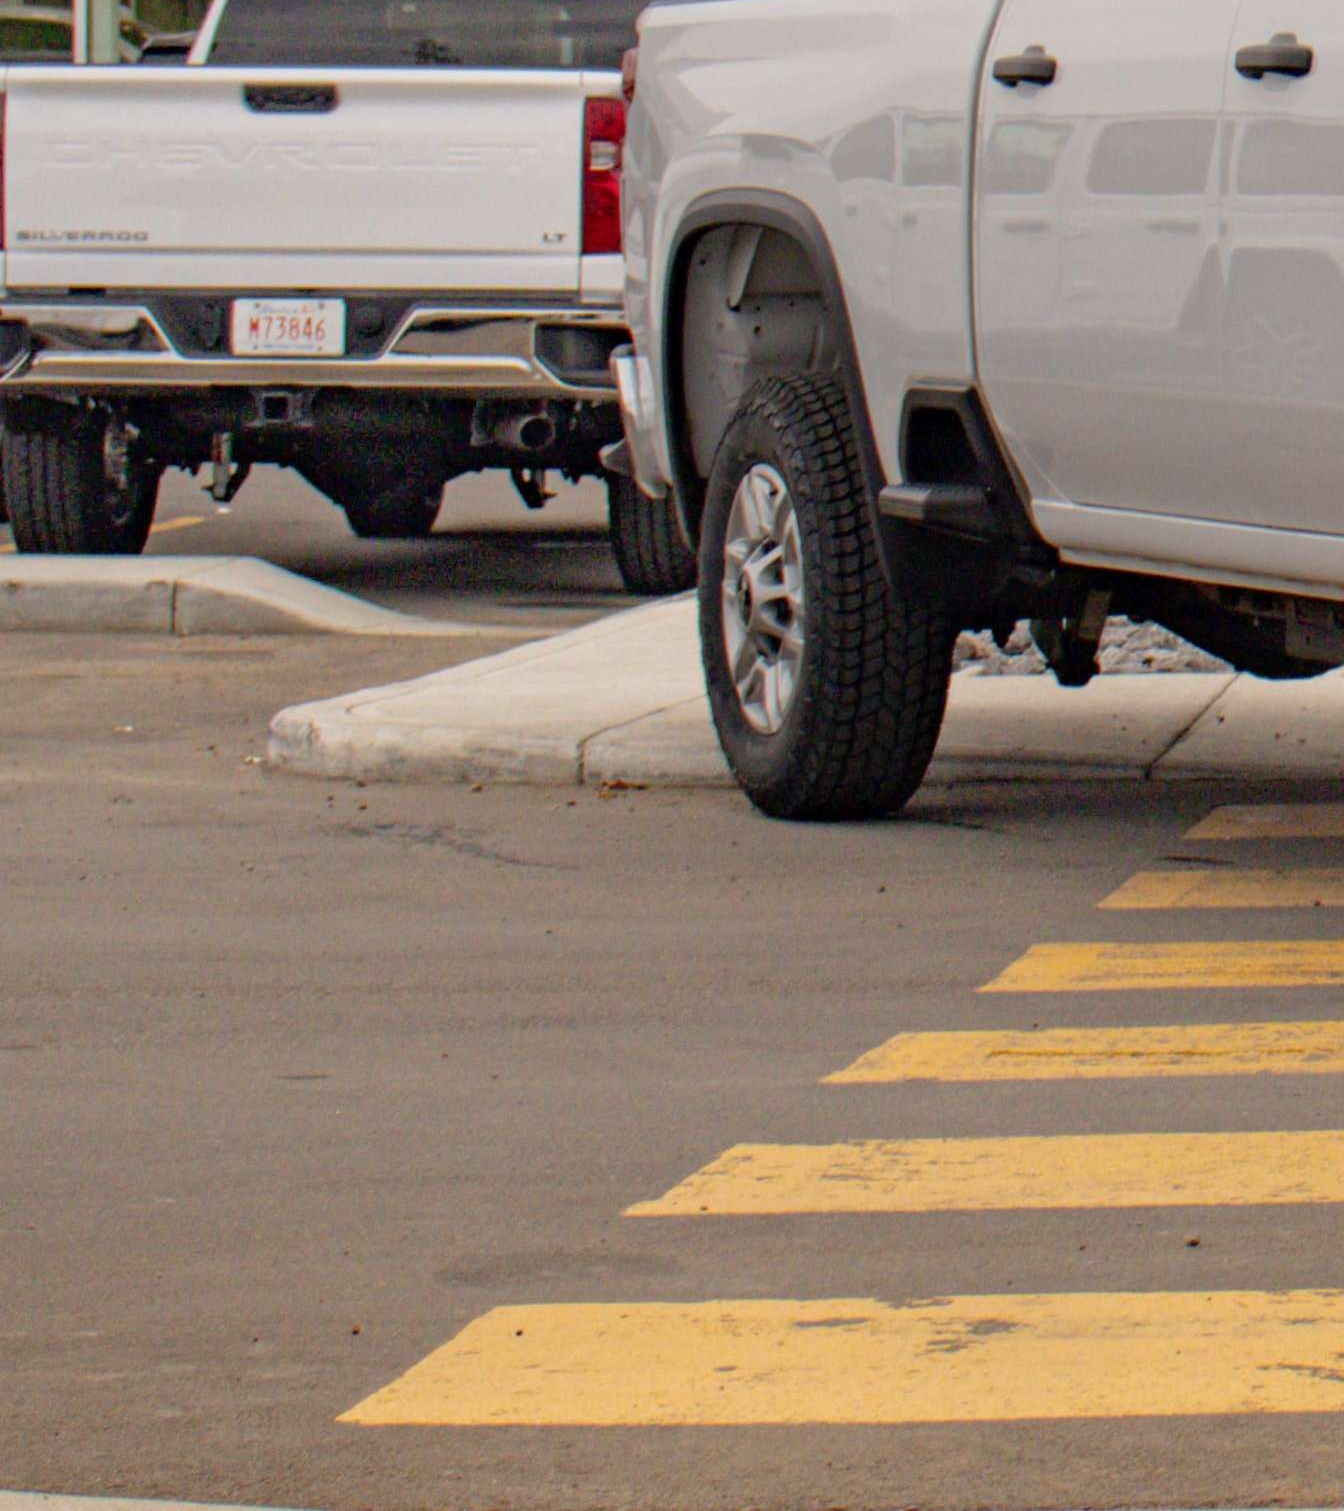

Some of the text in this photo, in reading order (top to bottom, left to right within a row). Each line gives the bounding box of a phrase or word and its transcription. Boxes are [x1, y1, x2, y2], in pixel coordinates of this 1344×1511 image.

[43, 139, 540, 172] CHEVROLET
[16, 230, 149, 241] SILVERADO
[542, 232, 568, 244] LT
